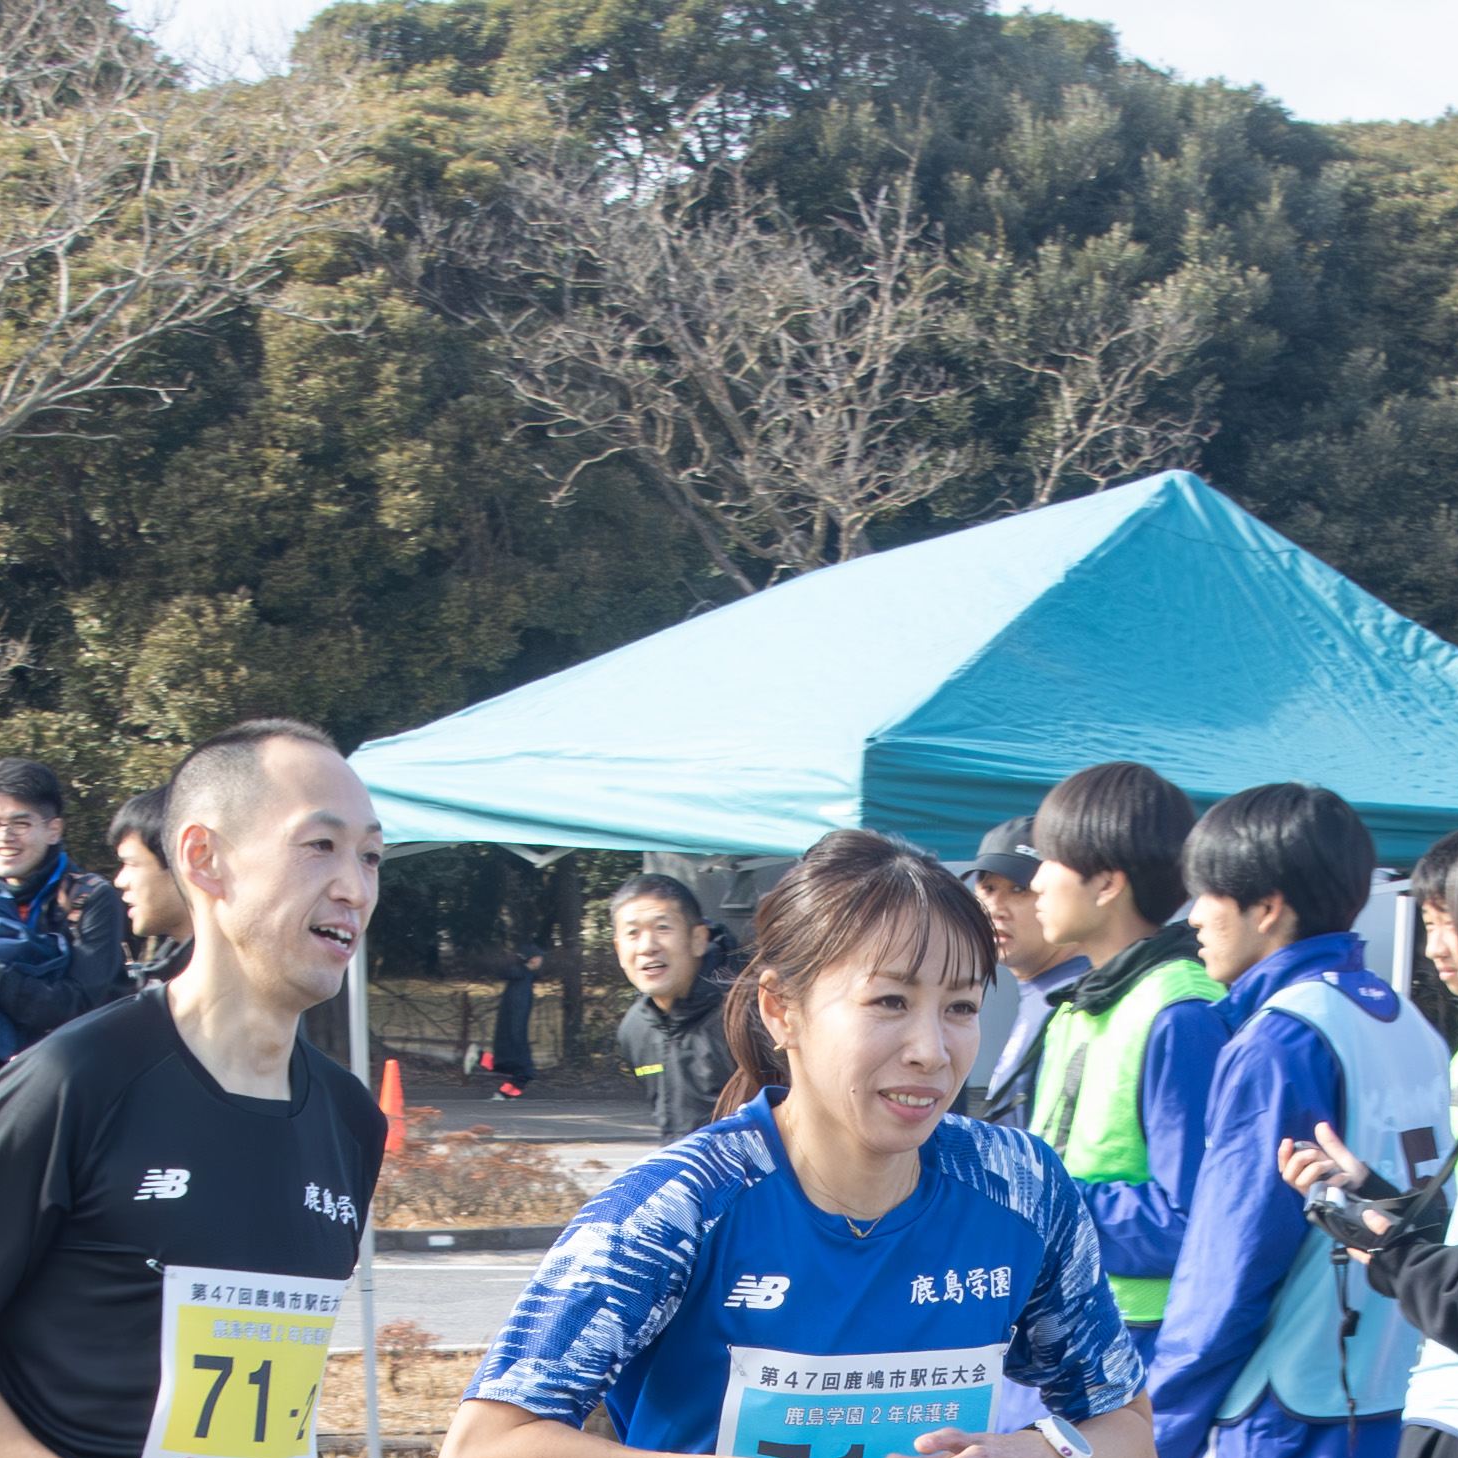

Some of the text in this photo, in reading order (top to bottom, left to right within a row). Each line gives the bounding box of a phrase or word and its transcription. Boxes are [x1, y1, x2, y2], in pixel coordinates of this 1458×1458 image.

[303, 1181, 359, 1232] 鹿島学
[909, 1266, 1012, 1304] 鹿島学園
[193, 1353, 318, 1443] 71-2
[759, 1363, 987, 1391] 第47回鹿嶋市駅伝大会
